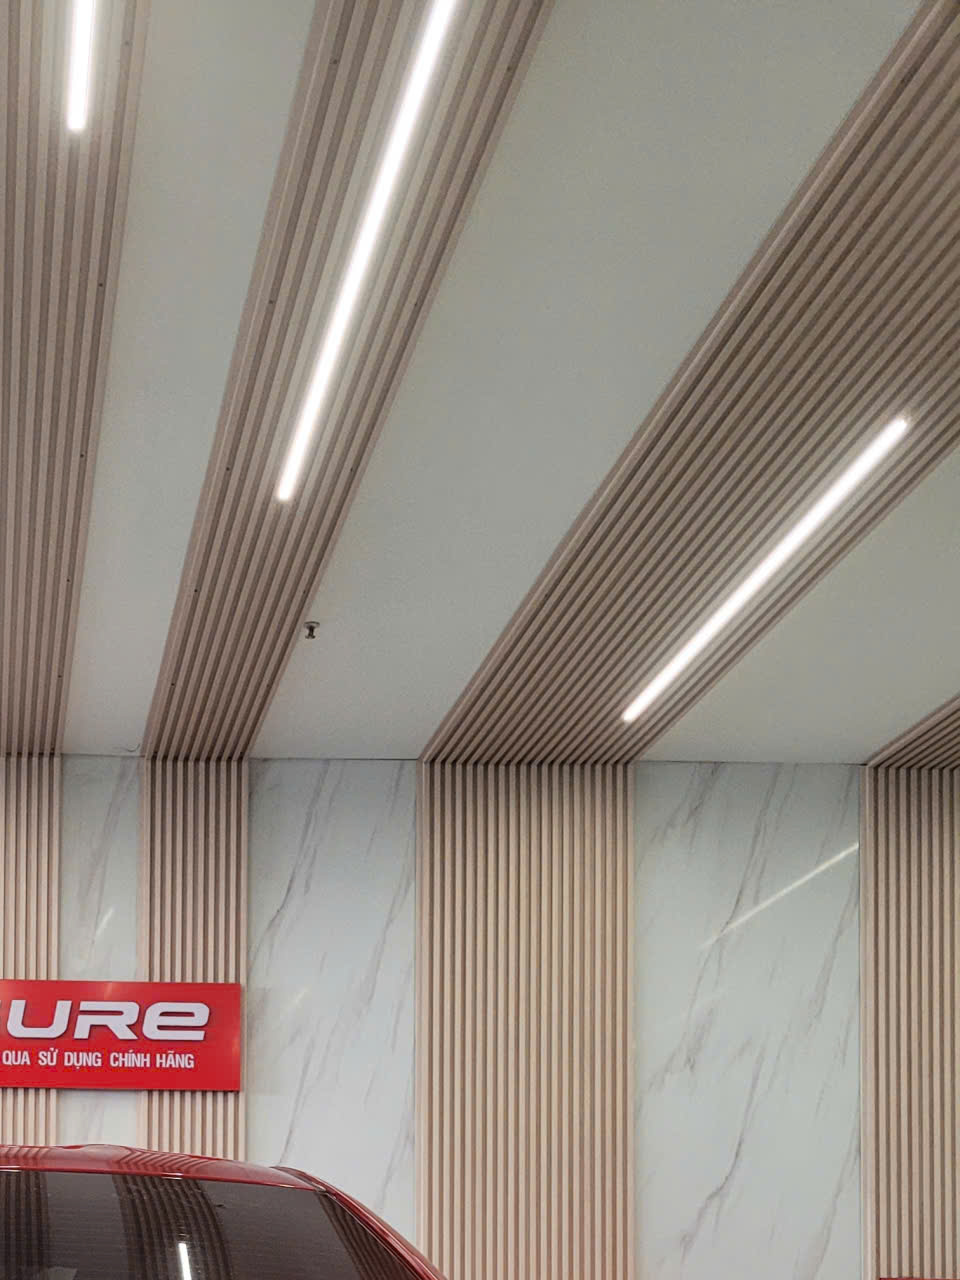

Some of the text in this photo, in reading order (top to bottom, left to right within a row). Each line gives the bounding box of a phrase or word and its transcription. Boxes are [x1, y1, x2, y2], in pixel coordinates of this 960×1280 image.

[2, 1050, 31, 1066] QUA
[38, 1047, 59, 1066] SỬ
[63, 1051, 102, 1069] DỤNG
[109, 1049, 150, 1068] CHÍNH
[156, 1050, 195, 1069] HÃNG
